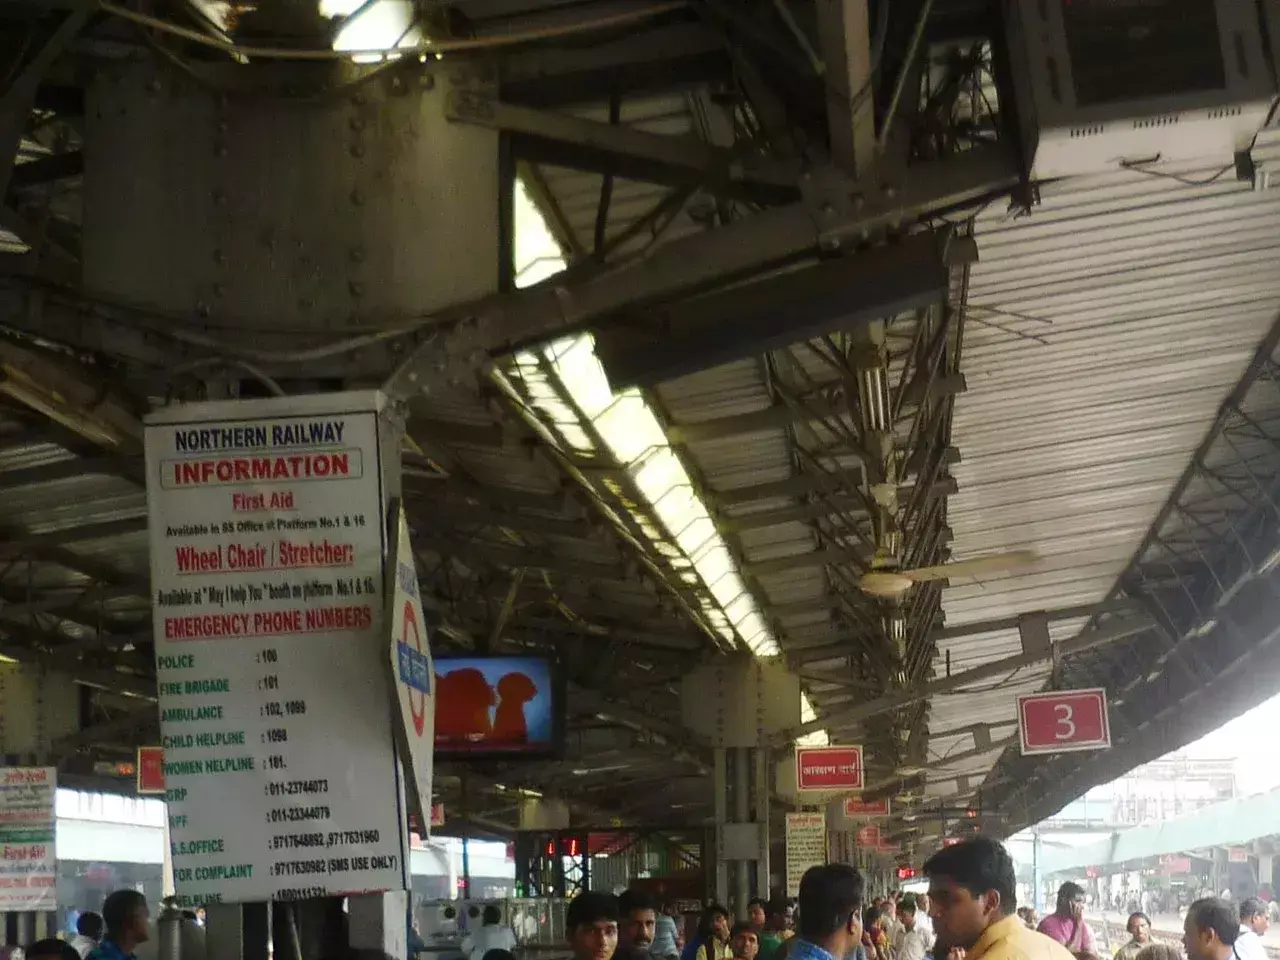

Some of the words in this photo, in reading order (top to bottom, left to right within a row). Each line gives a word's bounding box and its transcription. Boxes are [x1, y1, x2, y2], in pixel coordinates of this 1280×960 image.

[175, 425, 267, 451] NORTHERN
[272, 421, 345, 446] RAILWAY
[174, 454, 349, 485] INFORMATION
[232, 492, 265, 511] First
[270, 491, 294, 509] Aid
[166, 525, 208, 538] Available
[222, 521, 234, 533] SS
[237, 520, 265, 533] Office
[277, 518, 317, 531] Platform
[176, 544, 222, 571] Wheel
[228, 542, 266, 569] Chair
[165, 613, 250, 639] EMERGENCY
[254, 610, 301, 635] PHONE
[306, 606, 372, 632] NUMBERS
[158, 655, 195, 670] POLICE
[160, 682, 182, 697] FIRE
[185, 679, 230, 695] BRIGADE
[162, 706, 223, 722] AMBULANCE
[1054, 704, 1075, 740] 3
[162, 733, 193, 749] CHILD
[196, 731, 245, 747] HELPLINE
[164, 760, 203, 776] WOMEN
[205, 757, 255, 774] HELPLINE
[175, 867, 193, 883] FOR
[195, 864, 253, 881] COMPLAINT
[352, 857, 369, 872] USE
